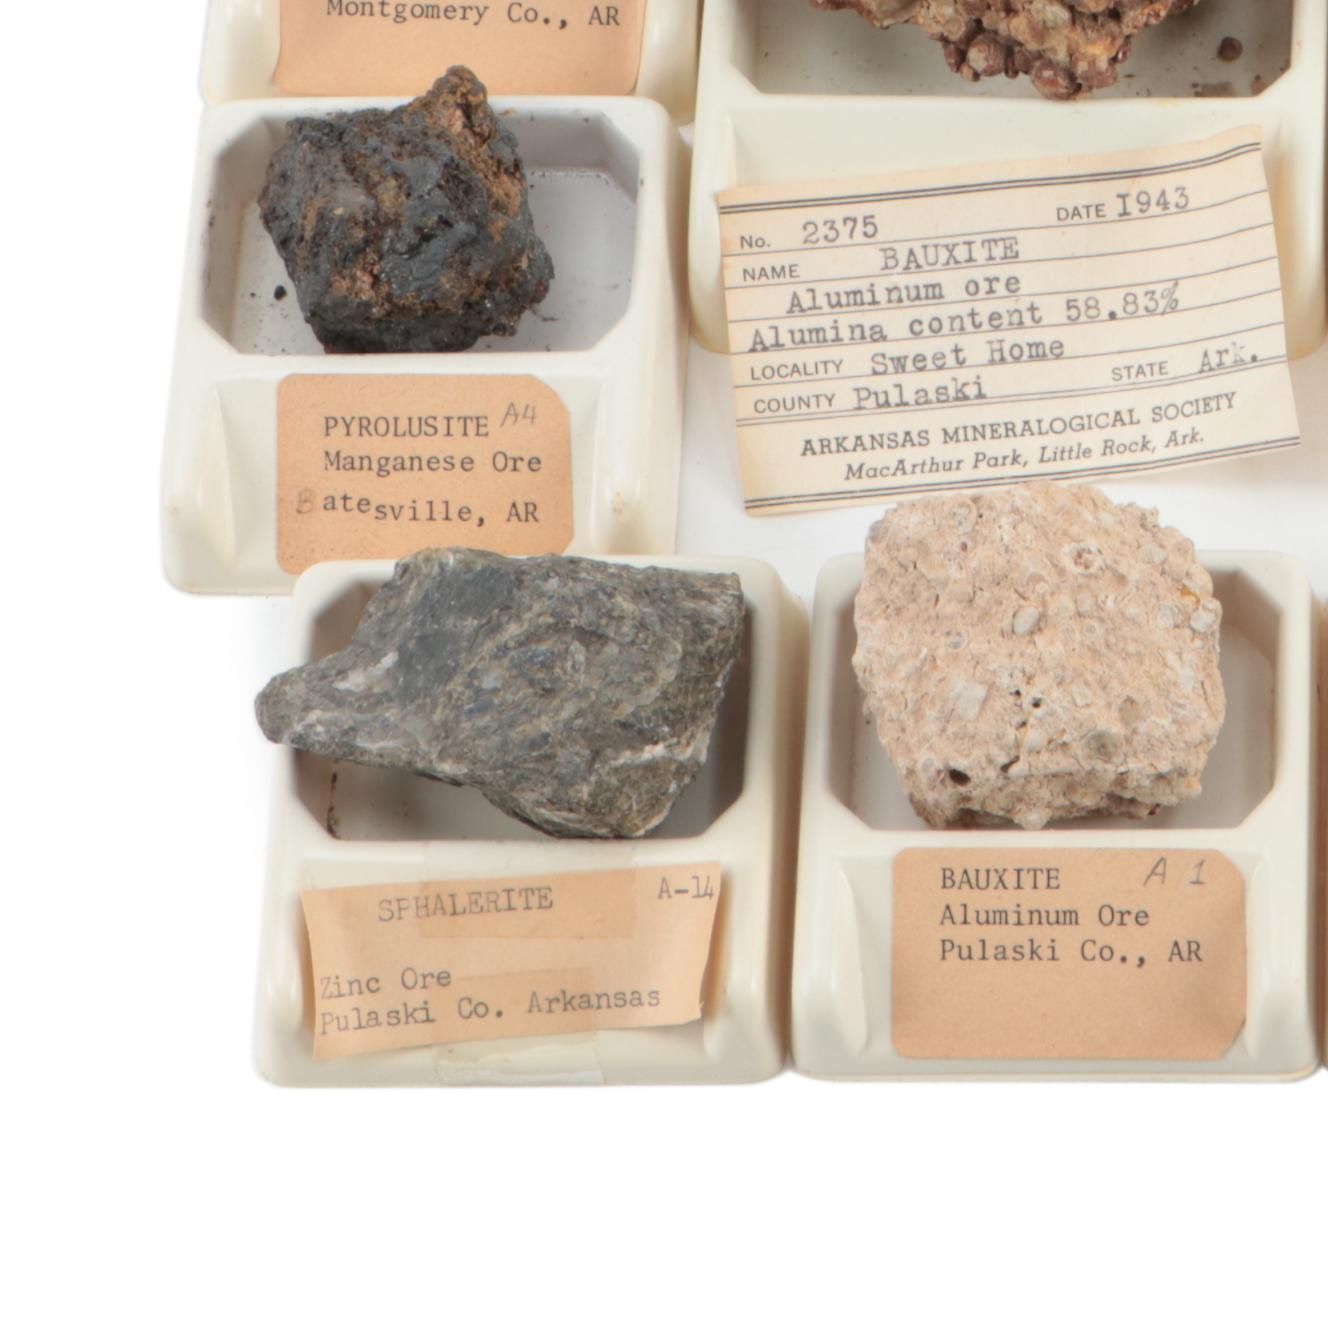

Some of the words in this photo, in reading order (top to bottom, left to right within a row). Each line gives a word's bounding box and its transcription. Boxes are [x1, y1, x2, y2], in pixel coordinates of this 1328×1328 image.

[507, 2, 568, 30] Co.,
[588, 6, 621, 26] AR
[740, 234, 772, 250] No.
[801, 214, 879, 245] 2375
[1056, 203, 1107, 222] DATE
[742, 263, 801, 283] NAME
[879, 236, 1020, 272] BAUXITE
[786, 282, 945, 315] Aluminum
[964, 275, 1021, 298] ore
[748, 318, 888, 354] Alumina
[908, 301, 1042, 338] content
[1065, 280, 1180, 322] 58.83%
[750, 359, 844, 382] LOCALITY
[870, 343, 968, 377] Sweet
[985, 338, 1065, 365] Home
[753, 393, 837, 415] COUNTY
[852, 375, 988, 412] Pulaski
[1111, 360, 1169, 383] STATE
[1196, 341, 1258, 374] Ark.
[324, 415, 490, 438] PYROLUSITE
[500, 402, 538, 428] A4
[801, 429, 930, 458] ARKANSAS
[942, 408, 1141, 446] MINERALOGICAL
[1151, 390, 1239, 424] SOCIETY
[324, 450, 475, 478] Manganese
[492, 450, 542, 472] Ore
[844, 453, 963, 482] MacArthur
[972, 447, 1029, 473] Park,
[1037, 440, 1095, 465] Little
[1100, 433, 1158, 460] Rock,
[1163, 426, 1206, 451] Ark.
[506, 501, 540, 523] AR
[378, 885, 554, 923] SPHALERITE
[656, 875, 716, 900] A-14
[940, 867, 1061, 890] BAUXITE
[940, 903, 1080, 926] Aluminum
[1098, 903, 1150, 926] Ore
[940, 938, 1061, 962] Pulaski
[1080, 939, 1146, 969] Co.,
[1167, 940, 1204, 963] AR
[320, 974, 381, 1001] Zinc
[400, 967, 451, 991] Ore
[320, 1000, 436, 1036] Pulaski
[457, 997, 504, 1020] Co.
[527, 987, 661, 1015] Arkansas
